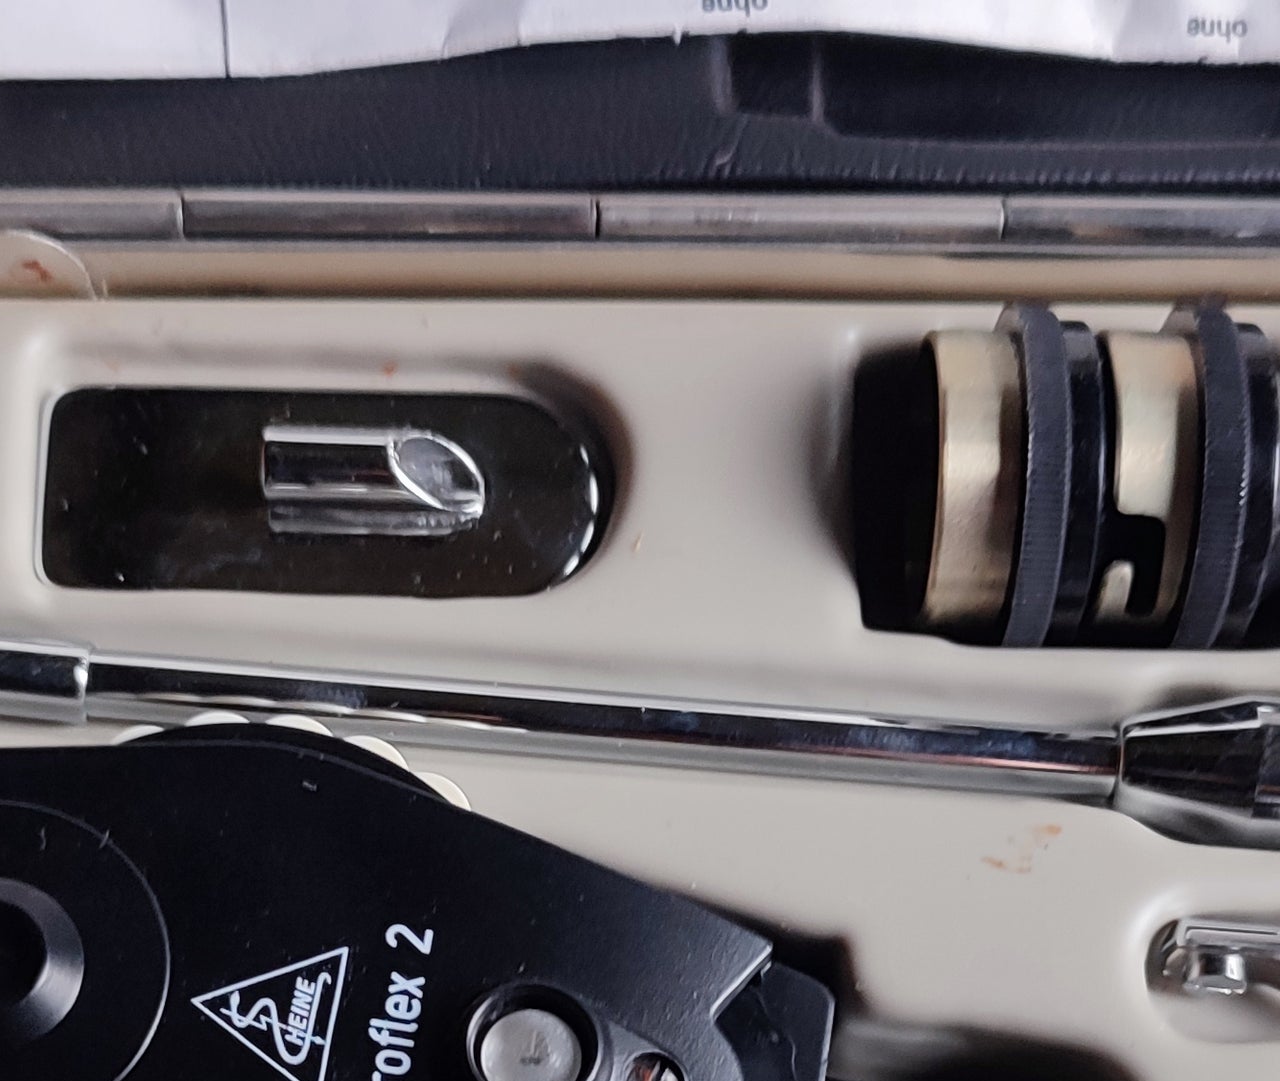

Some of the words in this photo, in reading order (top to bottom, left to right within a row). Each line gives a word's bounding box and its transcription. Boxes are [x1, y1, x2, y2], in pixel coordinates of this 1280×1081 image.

[1186, 18, 1248, 44] ohne
[385, 923, 434, 955] 2
[284, 975, 317, 1047] HEINE
